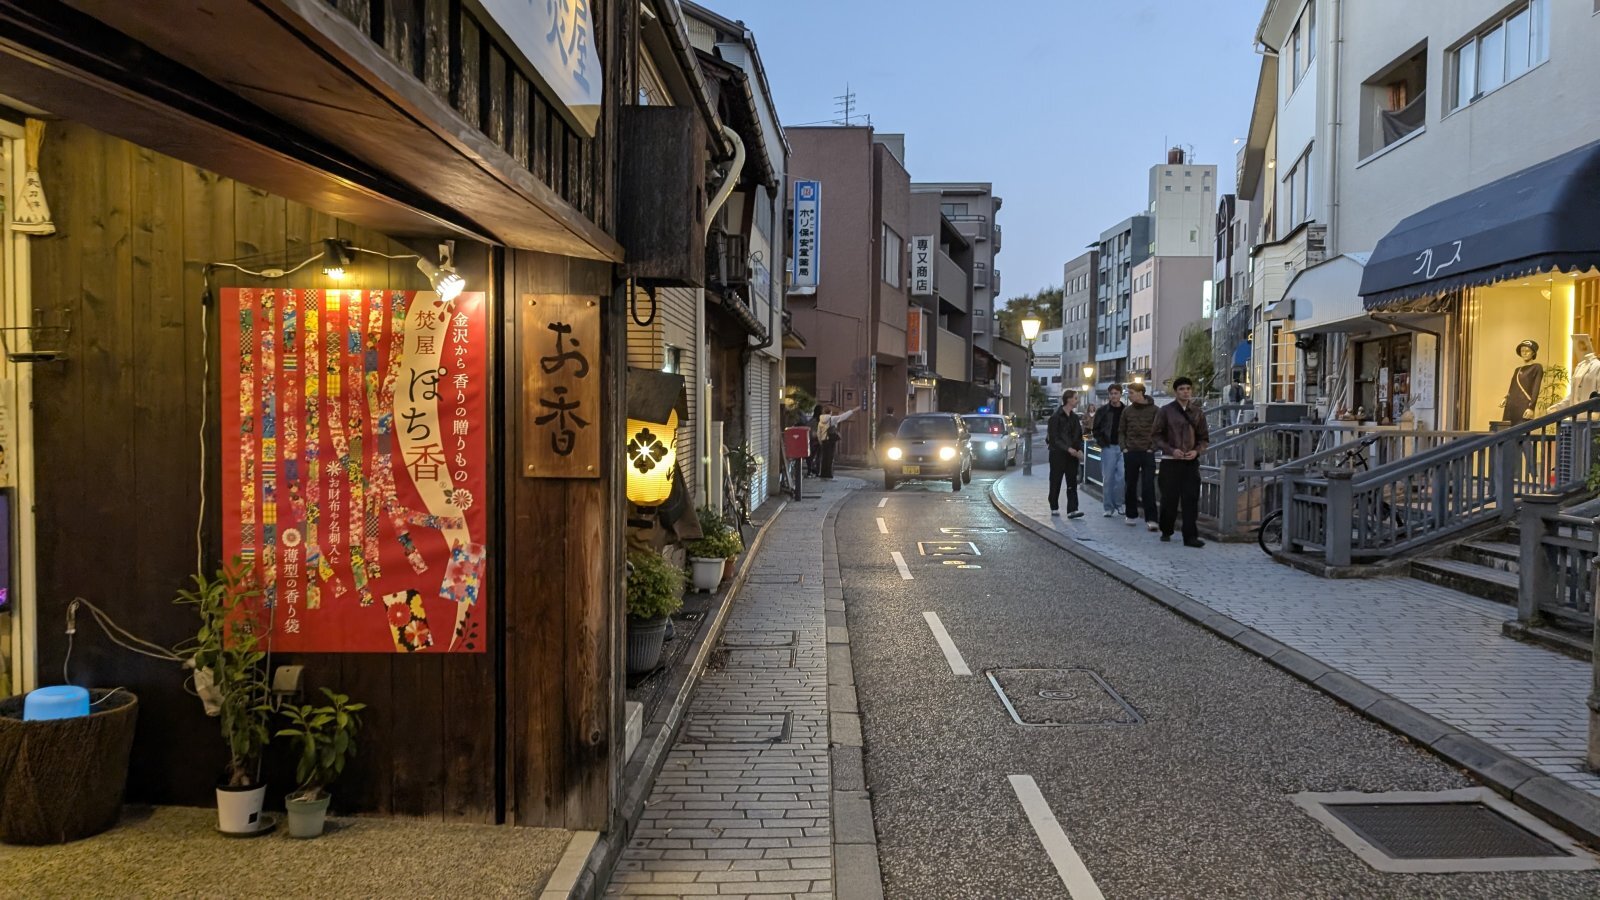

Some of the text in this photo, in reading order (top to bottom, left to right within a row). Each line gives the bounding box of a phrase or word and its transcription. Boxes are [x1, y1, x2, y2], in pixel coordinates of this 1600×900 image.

[916, 239, 928, 291] 専又商店
[401, 310, 448, 482] 焚屋 ぽち香
[452, 311, 470, 482] 金沢から香りの贈りもの
[534, 321, 591, 457] お香
[328, 477, 341, 564] お財布や名刺入に
[283, 548, 300, 634] 薄型の香り袋
